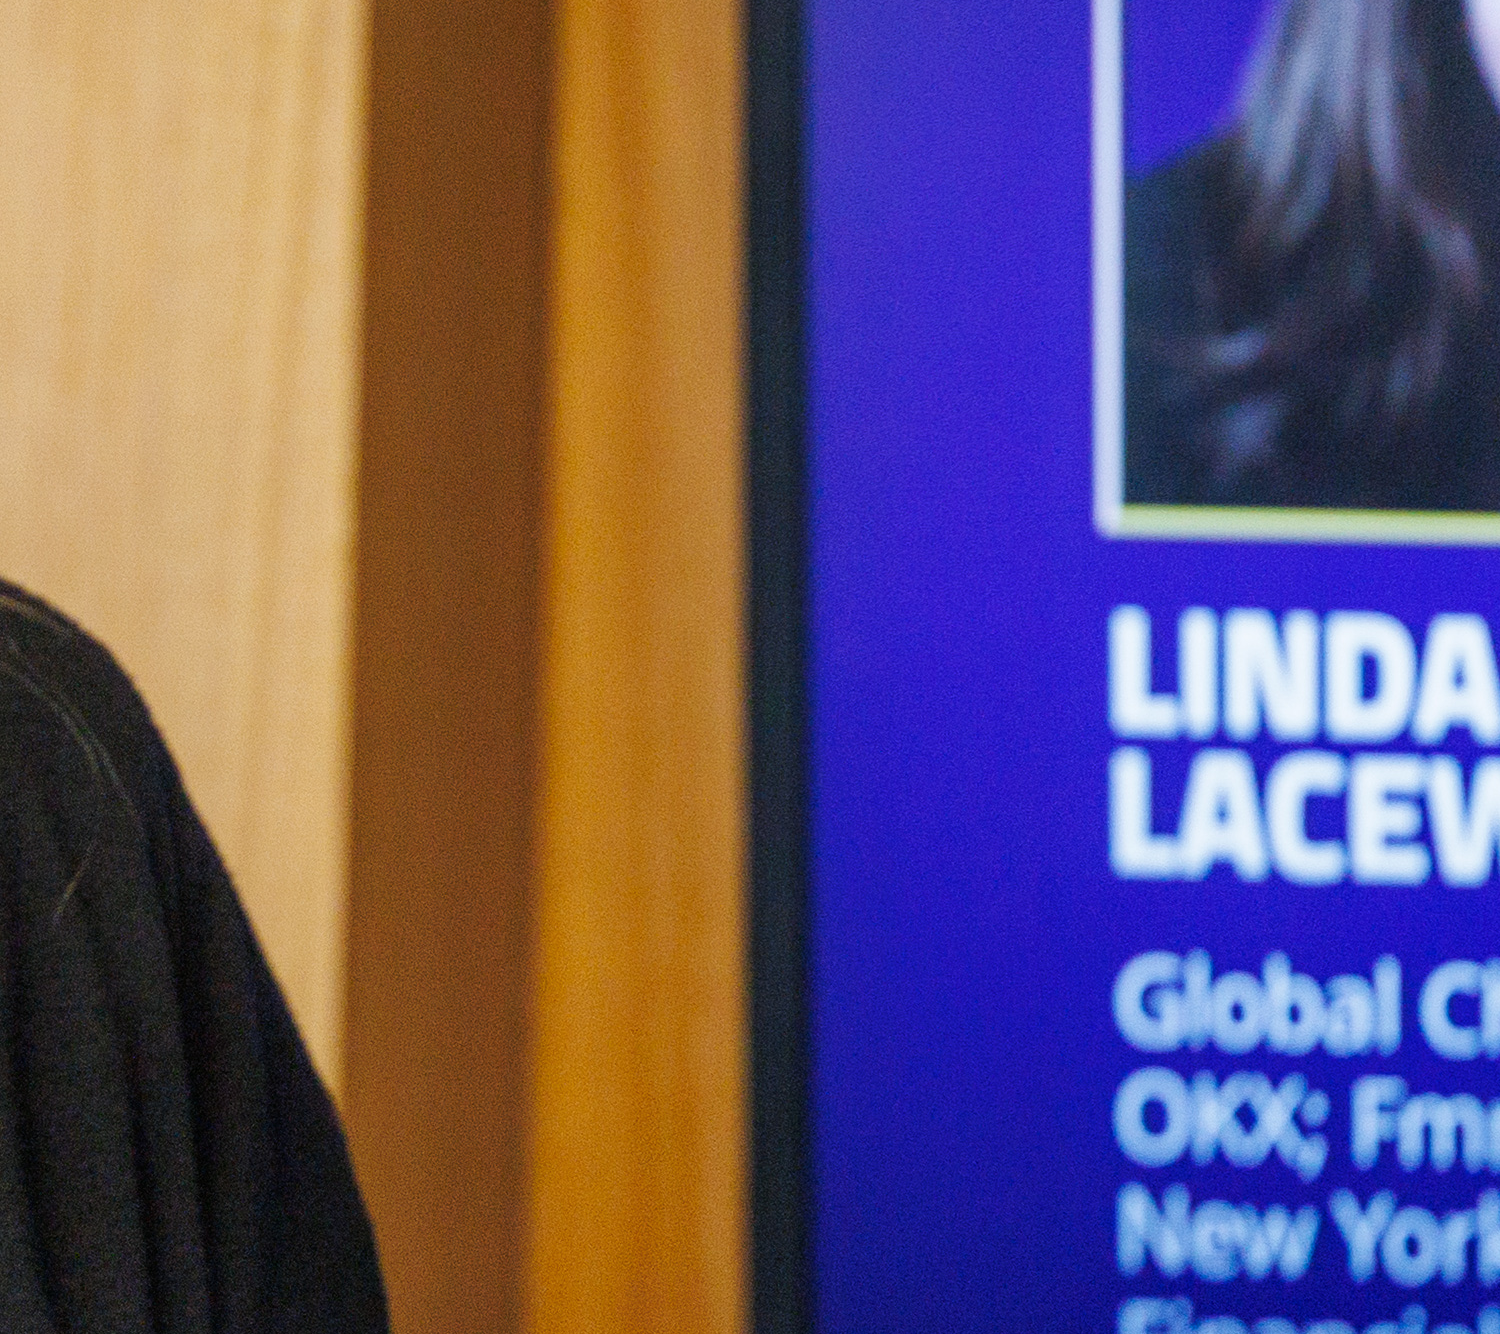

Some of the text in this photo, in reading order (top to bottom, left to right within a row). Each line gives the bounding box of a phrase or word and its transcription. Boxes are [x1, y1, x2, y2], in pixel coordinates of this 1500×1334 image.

[1113, 949, 1402, 1054] Global
[1113, 1067, 1329, 1180] OKX;
[1117, 1183, 1320, 1281] New
